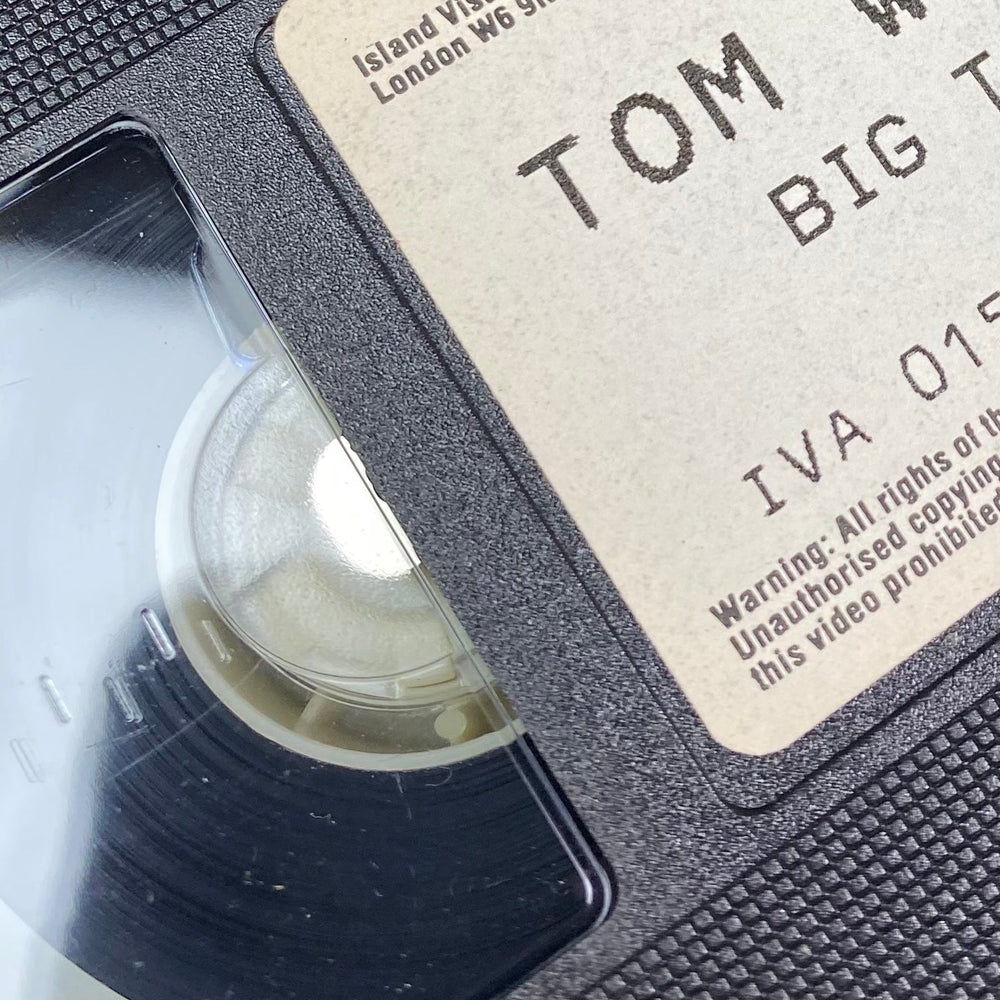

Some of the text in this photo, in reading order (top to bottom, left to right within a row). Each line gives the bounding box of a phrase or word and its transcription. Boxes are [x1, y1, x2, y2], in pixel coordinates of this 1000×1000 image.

[351, 13, 440, 78] Island
[369, 36, 472, 105] London
[467, 5, 516, 44] W6
[515, 31, 785, 231] TOM
[766, 113, 928, 247] BIG
[741, 409, 873, 517] IVA
[708, 535, 835, 629] Warning:
[835, 500, 877, 545] All
[876, 450, 953, 515] rights
[952, 422, 982, 459] of
[729, 521, 907, 661] Unauthorised
[749, 644, 807, 692] this
[805, 590, 881, 651] video
